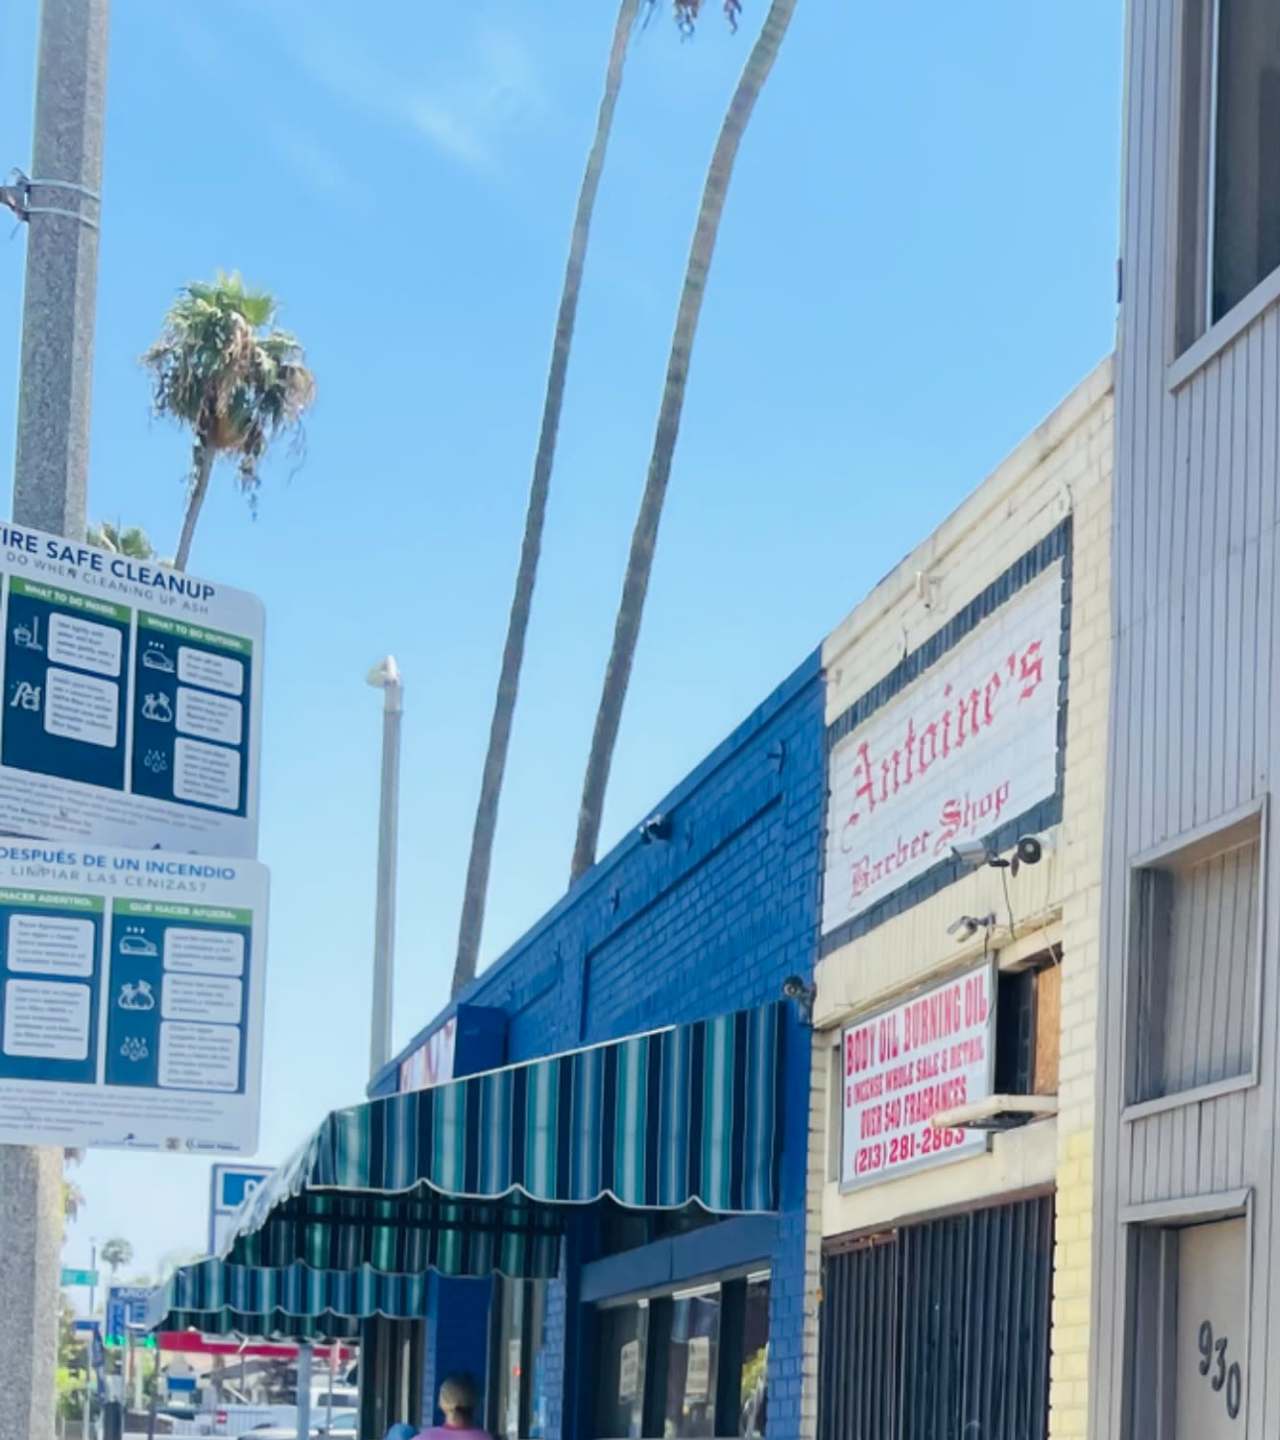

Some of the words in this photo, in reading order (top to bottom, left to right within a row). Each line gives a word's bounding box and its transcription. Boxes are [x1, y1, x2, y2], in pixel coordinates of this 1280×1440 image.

[0, 525, 38, 555] IRE
[46, 540, 104, 572] SAFE
[110, 559, 216, 602] CLEANUP
[6, 551, 28, 566] DO
[33, 559, 77, 579] WHEN
[82, 571, 154, 600] CLEANING
[160, 593, 178, 607] UP
[182, 600, 209, 615] ASH
[845, 640, 1044, 830] Antoine's
[83, 853, 107, 868] DE
[113, 855, 140, 871] UN
[146, 859, 236, 881] INCENDIO
[850, 830, 930, 899] Barber
[934, 780, 1010, 857] Shop
[11, 864, 79, 881] LIMPIAR
[87, 872, 117, 885] LAS
[124, 876, 207, 893] CENIZAS?
[847, 1026, 877, 1076] BODY
[879, 1015, 898, 1063] OIL
[904, 988, 961, 1051] BURNING
[965, 975, 988, 1029] OIL
[885, 1060, 914, 1091] WHOLE
[916, 1051, 940, 1083] SALE
[860, 1104, 881, 1140] OVER
[854, 1143, 888, 1176] (213)
[1198, 1319, 1241, 1420] 930
